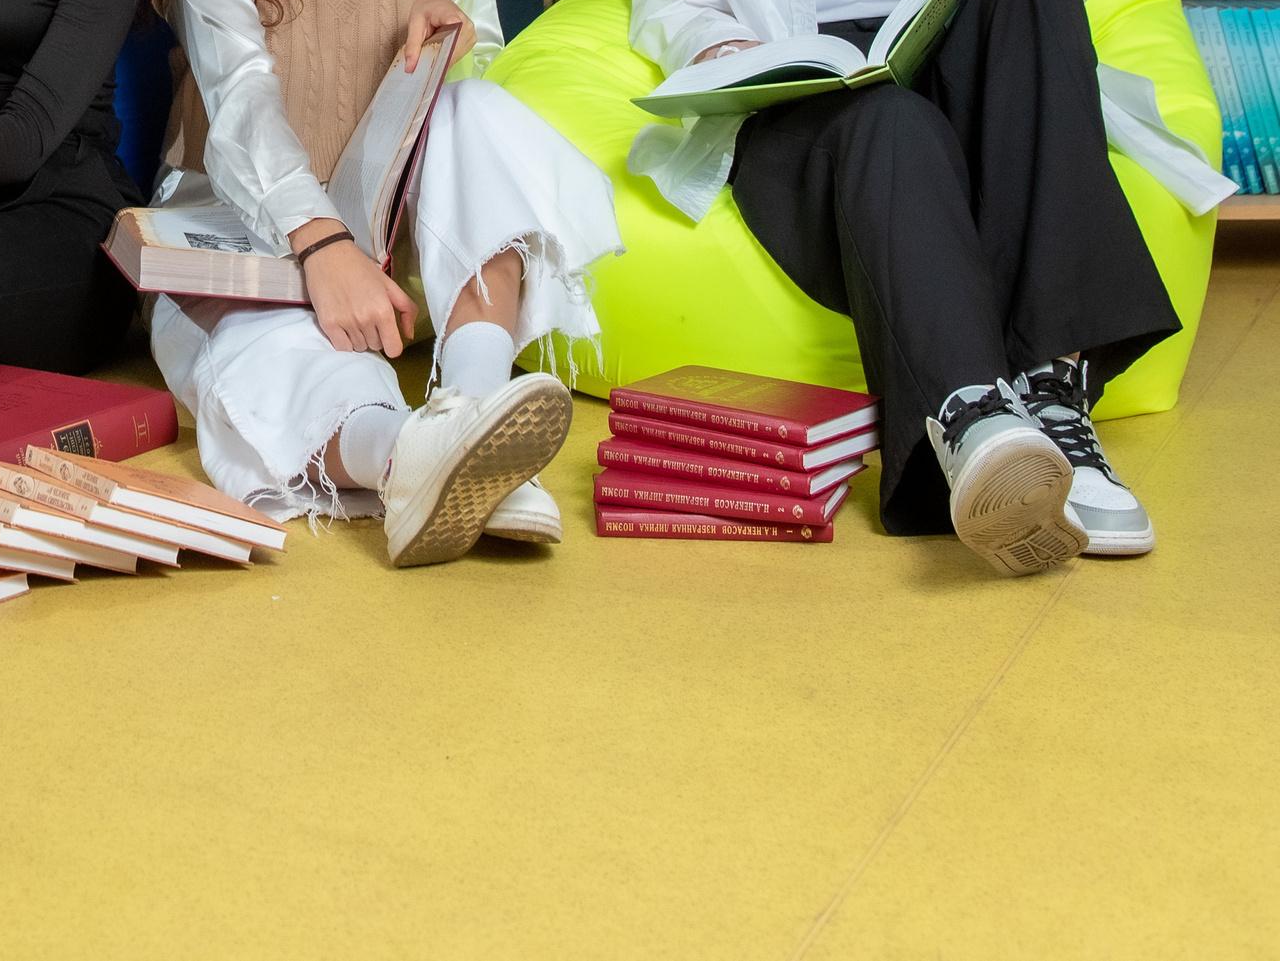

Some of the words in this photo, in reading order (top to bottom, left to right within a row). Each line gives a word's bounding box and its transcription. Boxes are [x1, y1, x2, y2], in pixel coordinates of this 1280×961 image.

[615, 396, 639, 410] ПОЭМЫ
[642, 401, 668, 413] ЛИРИКА
[669, 406, 708, 421] ИЗБРАННАЯ
[614, 420, 638, 433] ПОЭМЫ
[711, 414, 759, 432] Н.А.НЕКРАСОВ
[641, 426, 667, 439] ЛИРИКА
[668, 432, 706, 447] ИЗБРАННАЯ
[709, 439, 757, 457] Н.А.НЕКРАСОВ
[602, 450, 629, 463] ПОЭМЫ
[633, 454, 661, 468] ЛИРИКА
[707, 466, 759, 484] Н.А.НЕКРАСОВ
[601, 485, 629, 498] ПОЭМЫ
[633, 489, 663, 501] ЛИРИКА
[665, 493, 710, 507] ИЗБРАННАЯ
[714, 498, 770, 513] Н.А.НЕКРАСОВ
[605, 521, 634, 532] ПОЭМЫ
[638, 522, 669, 533] ЛИРИКА
[671, 523, 716, 534] ИЗБРАННАЯ
[721, 525, 777, 536] Н.А.НЕКРАСОВ
